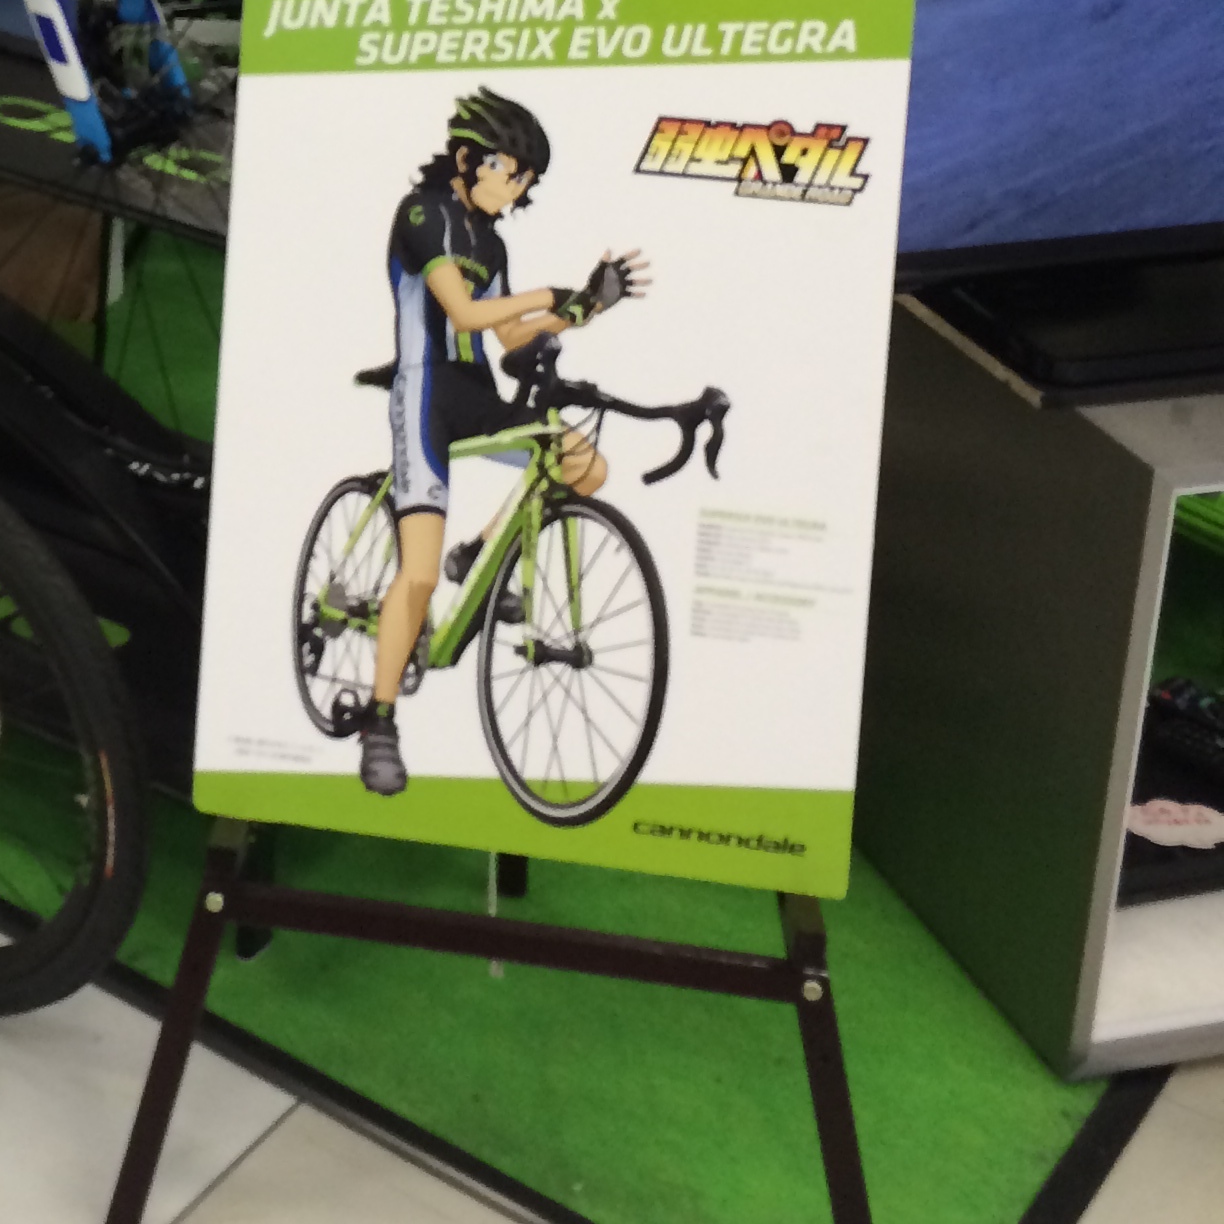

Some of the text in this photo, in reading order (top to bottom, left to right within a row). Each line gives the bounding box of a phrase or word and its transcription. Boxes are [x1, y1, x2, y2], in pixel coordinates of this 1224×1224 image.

[354, 18, 858, 67] SUPERSIX EVO ULTEGRA
[633, 821, 808, 857] cannondale
